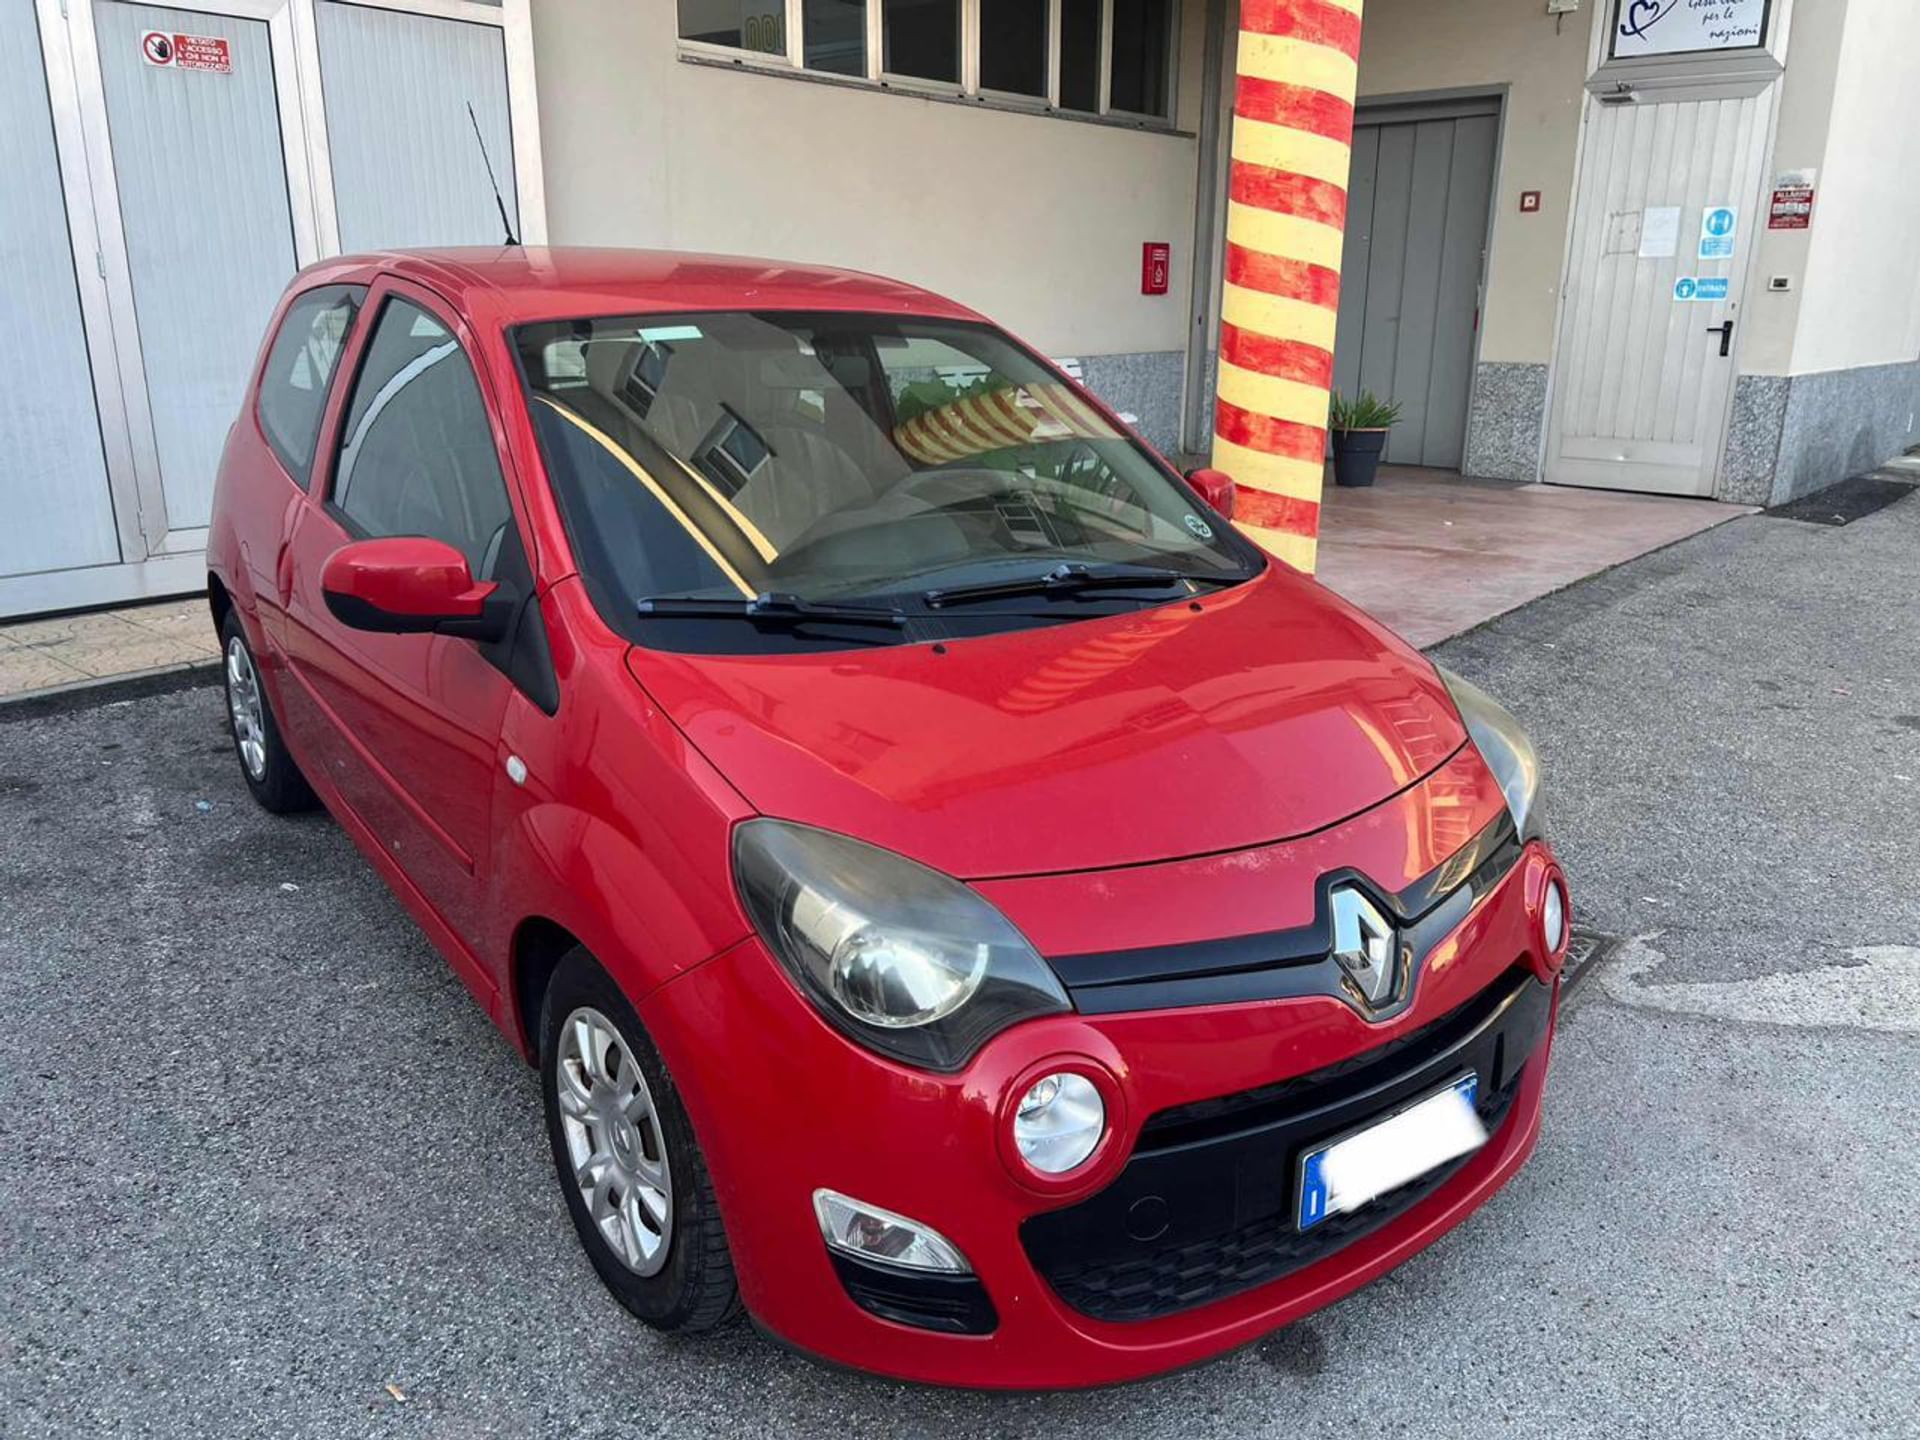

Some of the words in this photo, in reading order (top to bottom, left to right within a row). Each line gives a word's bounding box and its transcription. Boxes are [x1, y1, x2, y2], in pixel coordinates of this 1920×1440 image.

[1702, 12, 1719, 26] per
[1723, 6, 1733, 19] le
[1710, 24, 1758, 43] nazioni
[186, 37, 216, 47] VIETATO
[179, 43, 223, 55] L'ACCESSO
[185, 52, 200, 60] CHI
[201, 54, 219, 62] NON
